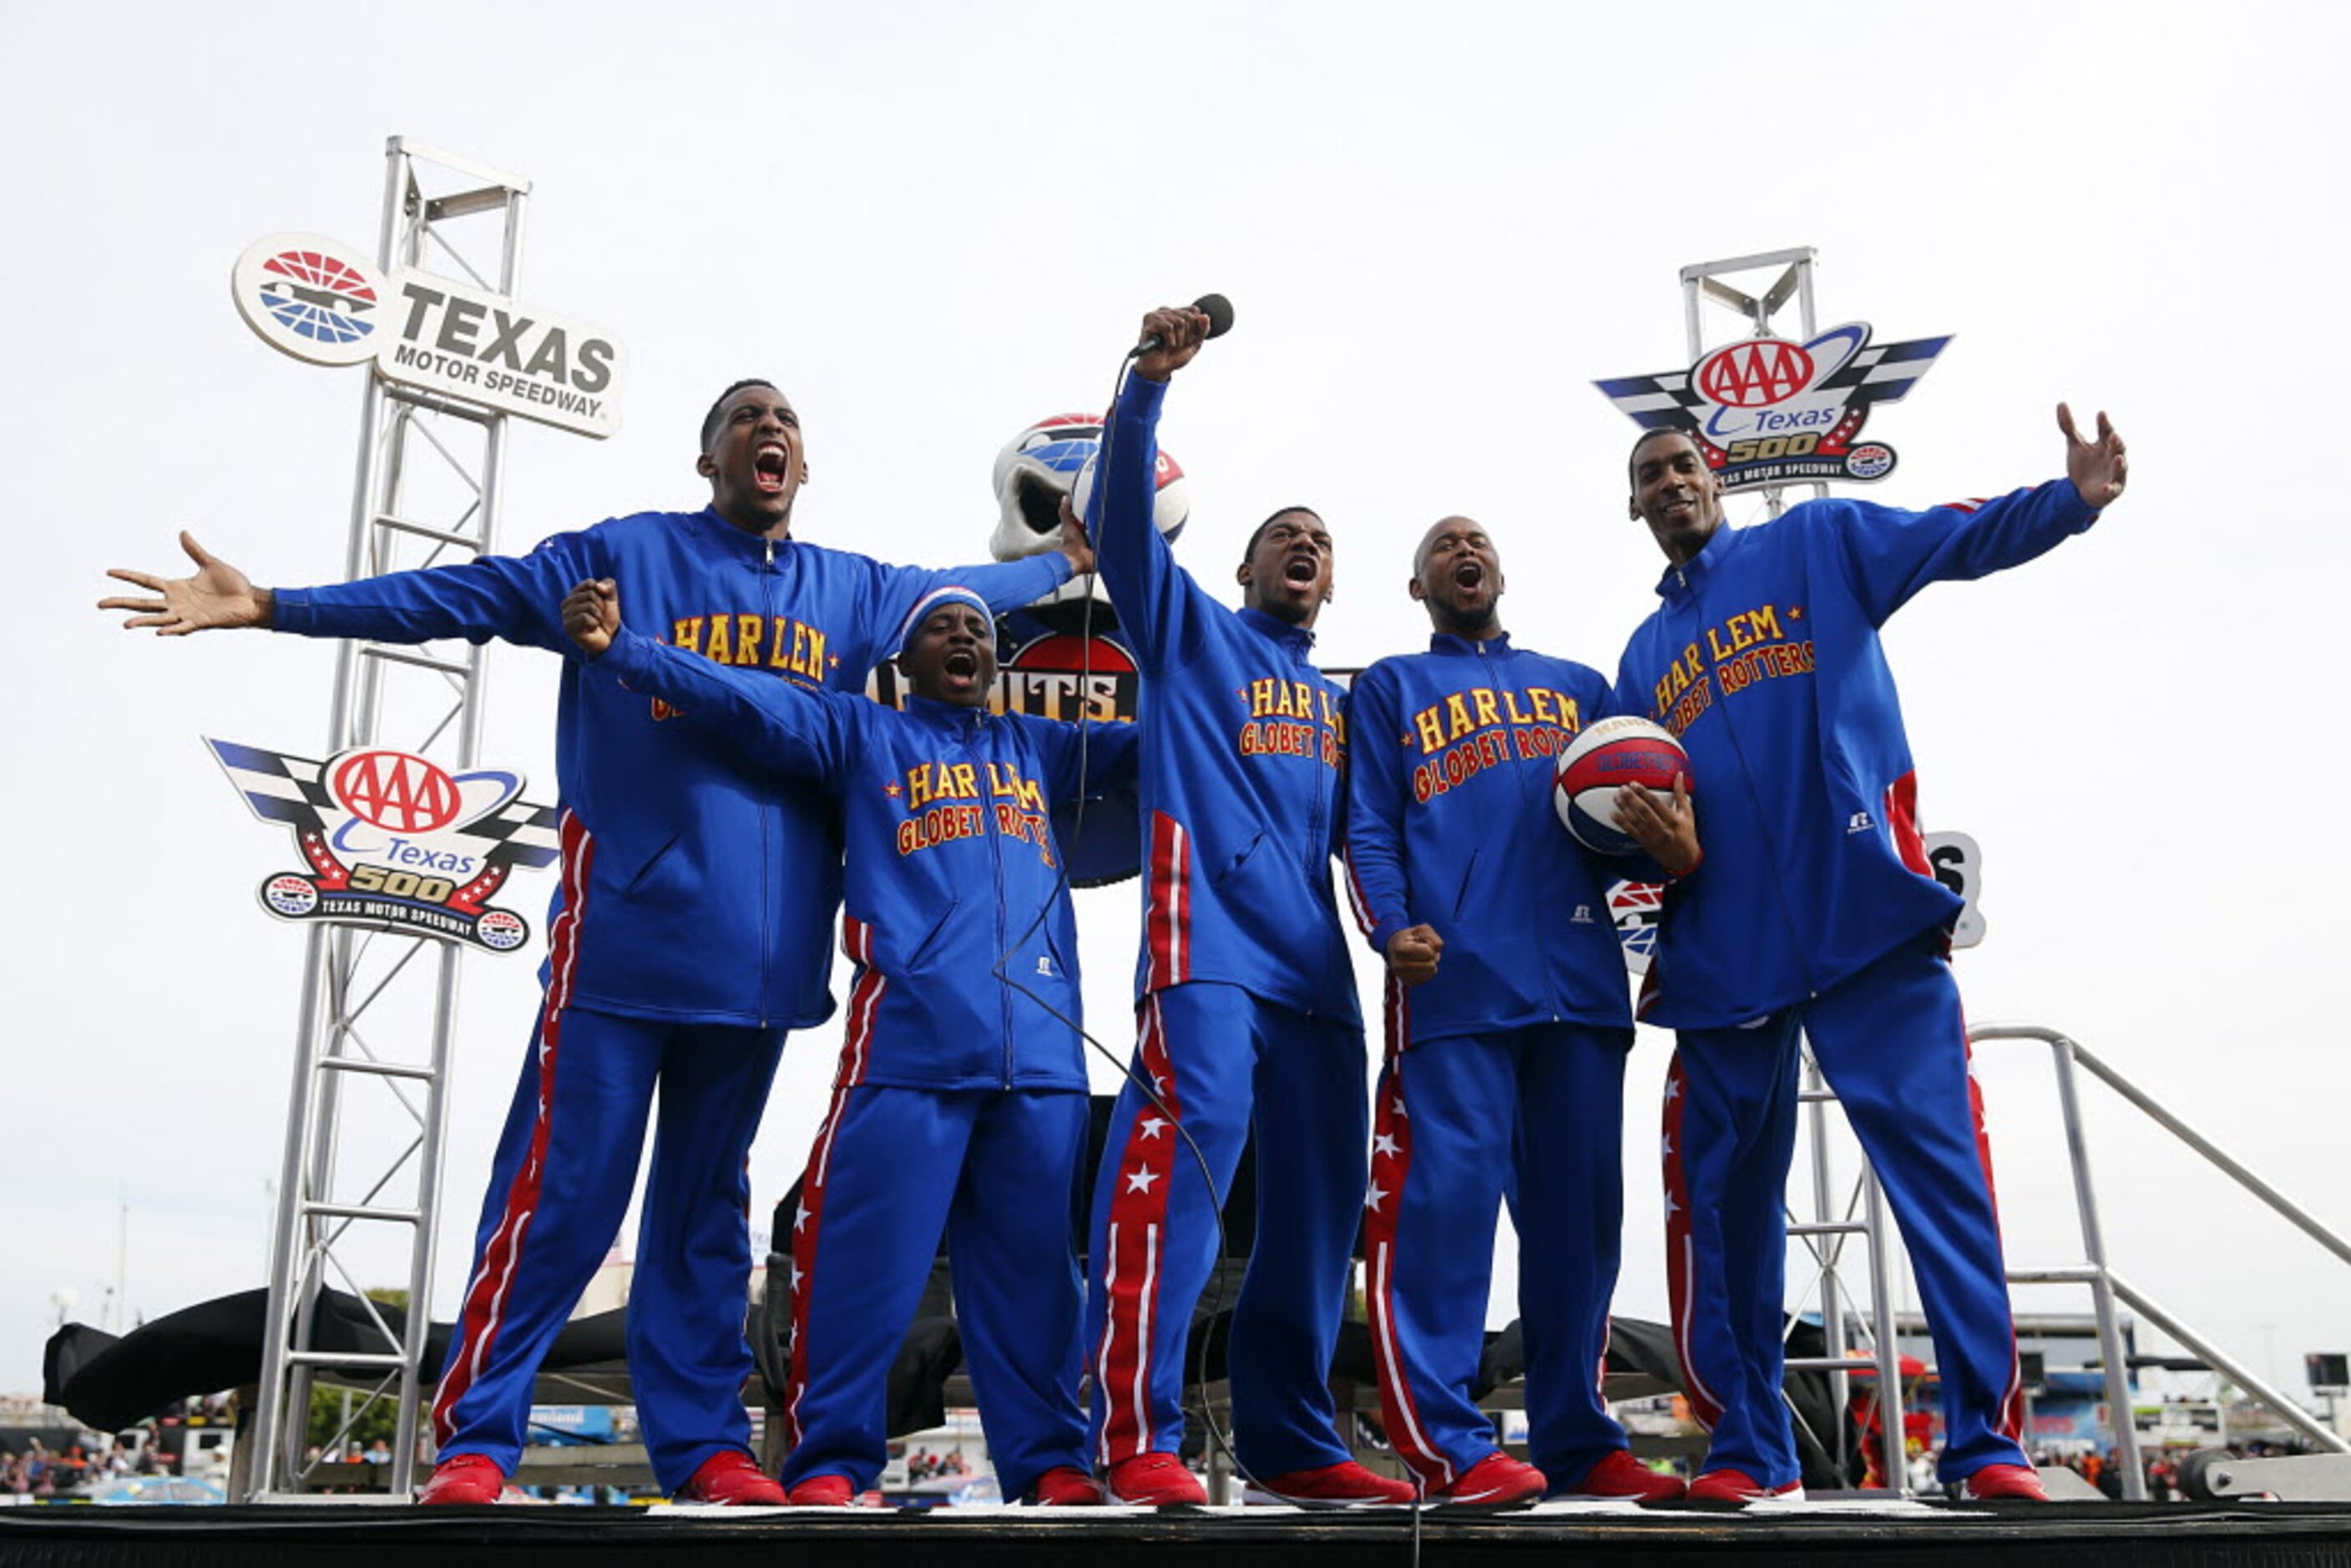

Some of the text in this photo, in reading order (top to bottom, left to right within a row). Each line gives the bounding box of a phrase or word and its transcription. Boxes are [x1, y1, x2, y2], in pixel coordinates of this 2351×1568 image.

[402, 282, 614, 393] TEXAS
[394, 344, 603, 419] MOTOR SPEEDWAY
[1706, 343, 1807, 406] AAA
[1727, 432, 1822, 463] 500
[1755, 407, 1835, 432] Texas
[1744, 465, 1782, 481] MOTOR
[1785, 463, 1843, 475] SPEEDWAY
[673, 612, 827, 685] HARLEM
[1653, 604, 1785, 718] HARLEM
[1414, 687, 1582, 756] HARLEM
[341, 752, 453, 832] AAA
[349, 862, 458, 904] 500
[387, 837, 476, 874] Texas
[322, 900, 473, 936] TEXAS MOTOR SPEEDWAY
